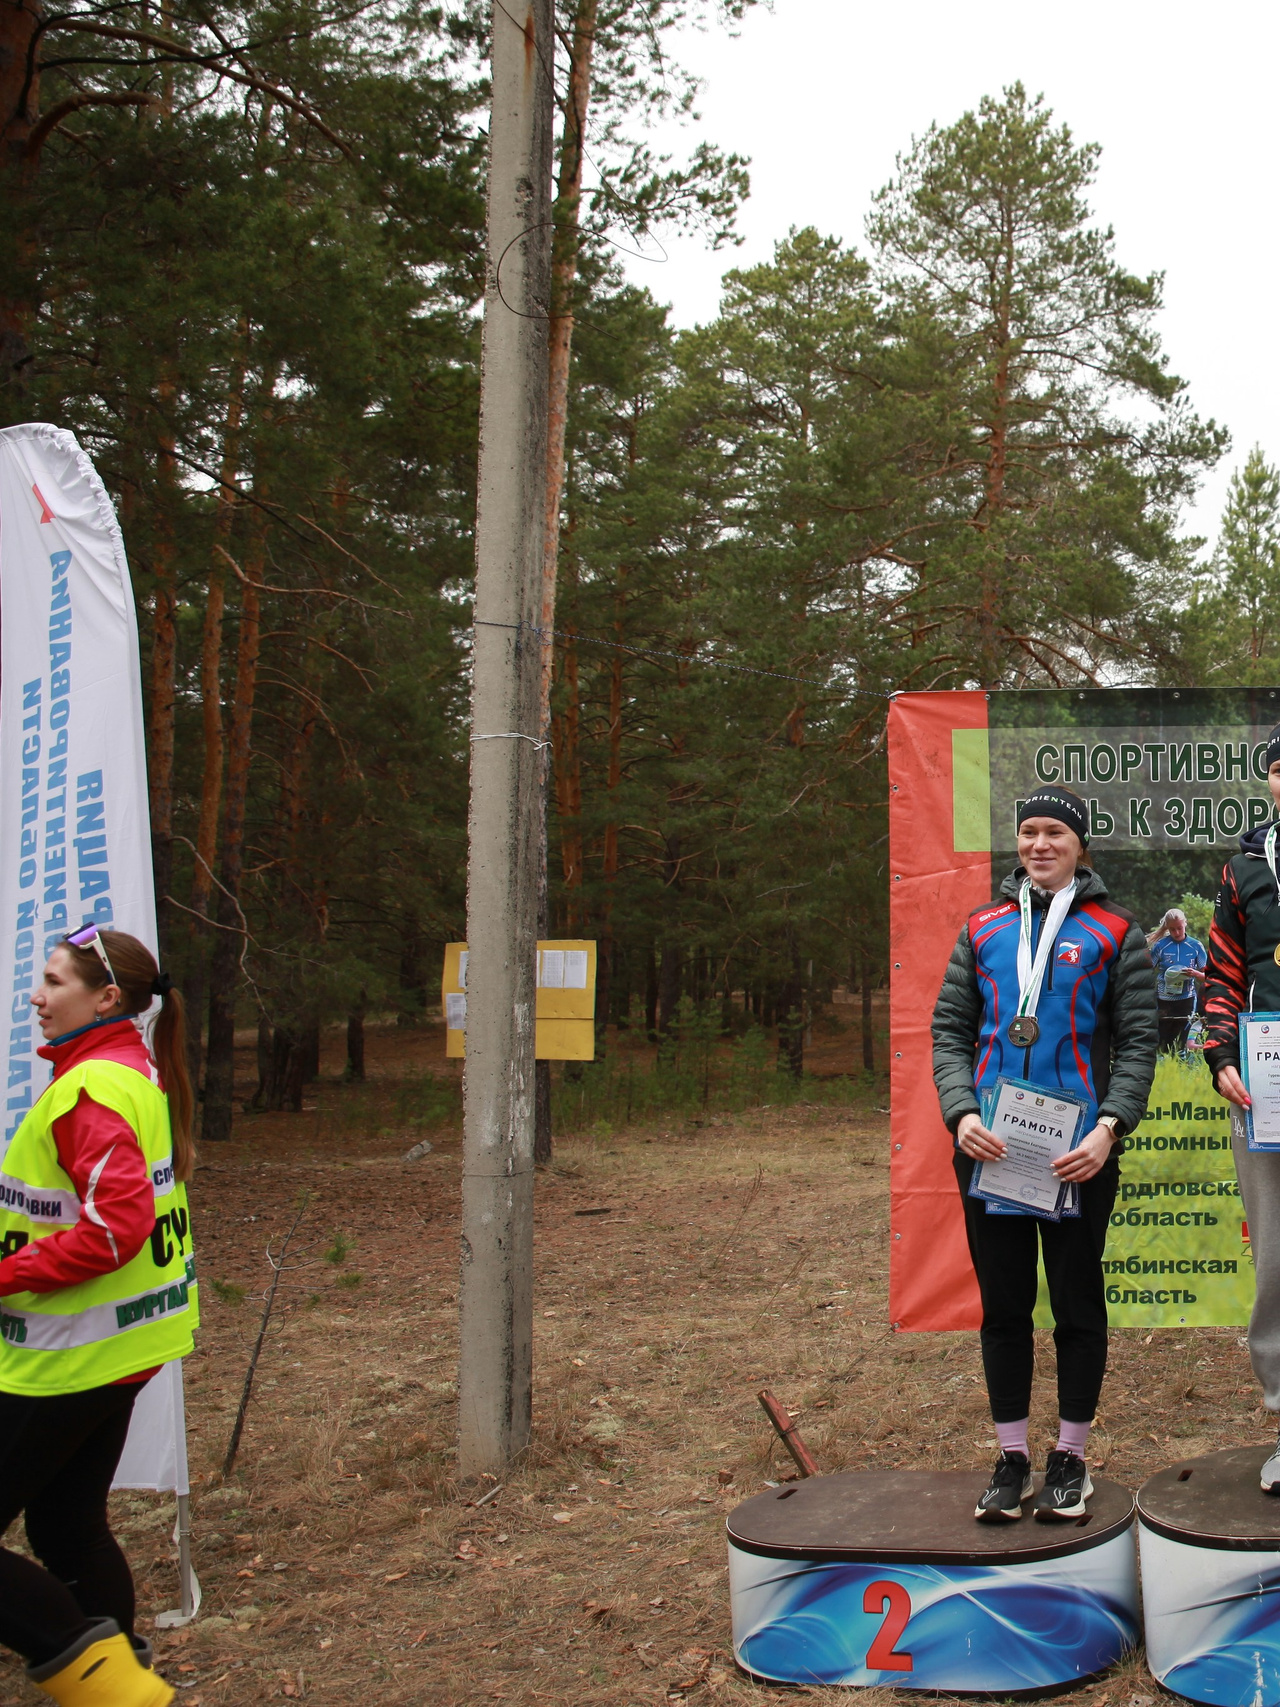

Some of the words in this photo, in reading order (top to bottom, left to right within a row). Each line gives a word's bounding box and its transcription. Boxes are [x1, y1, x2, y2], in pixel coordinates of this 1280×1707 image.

[1035, 743, 1268, 783] СПОРТИВНО
[1129, 797, 1152, 837] К
[1003, 1113, 1063, 1139] ГРАМОТА
[1110, 1207, 1218, 1227] область
[1101, 1256, 1238, 1275] лябинская
[1106, 1285, 1198, 1305] бласть
[863, 1580, 913, 1672] 2
